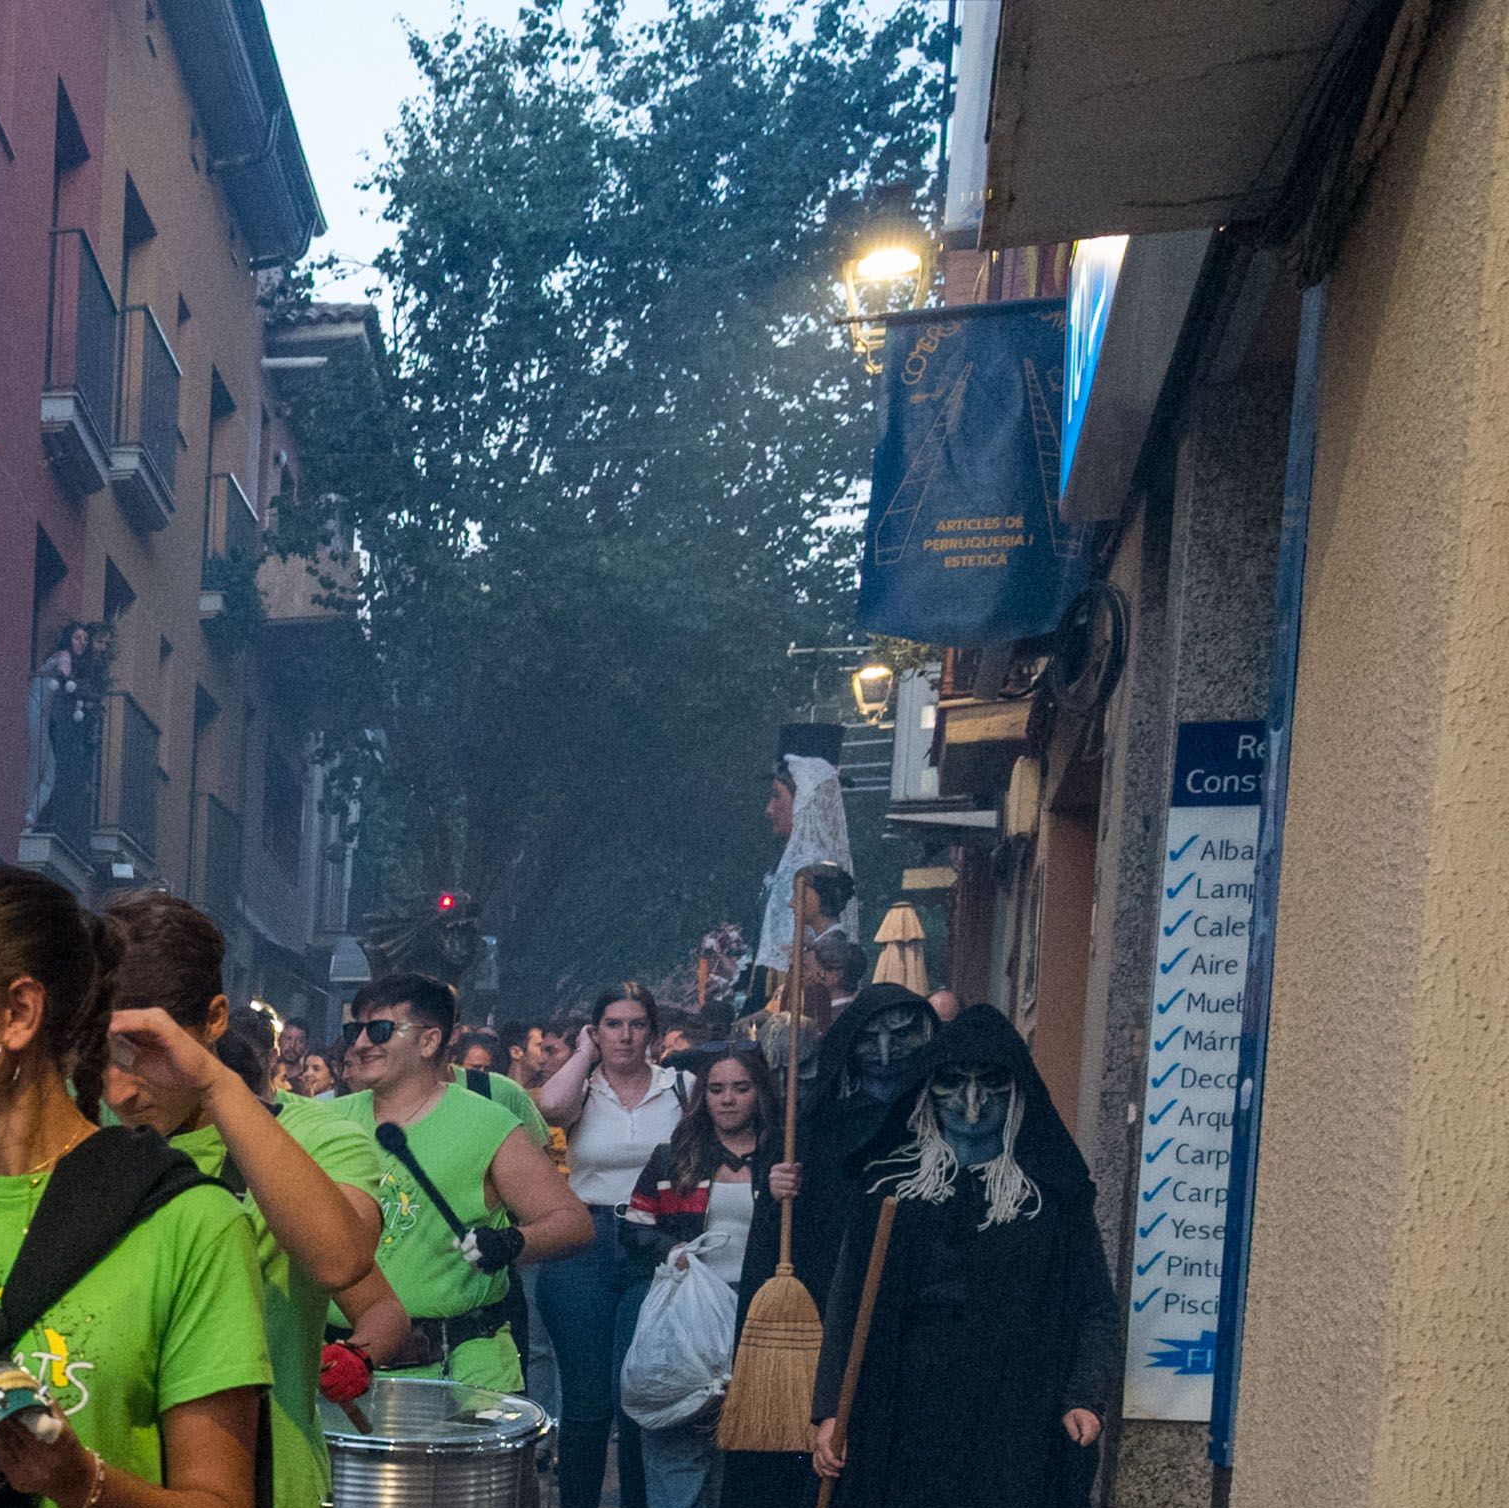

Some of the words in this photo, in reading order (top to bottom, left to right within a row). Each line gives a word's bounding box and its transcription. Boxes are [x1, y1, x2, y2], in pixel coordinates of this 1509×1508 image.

[936, 517, 1000, 532] ARTICLES
[1005, 516, 1025, 529] DE
[923, 534, 1025, 551] PERRUQUERIA
[1186, 768, 1262, 794] Cons
[1200, 838, 1254, 862] Alba
[1190, 953, 1239, 975] Aire
[1175, 1143, 1230, 1170] Carp
[1172, 1181, 1229, 1208] Carp
[1164, 1293, 1220, 1315] Pisci
